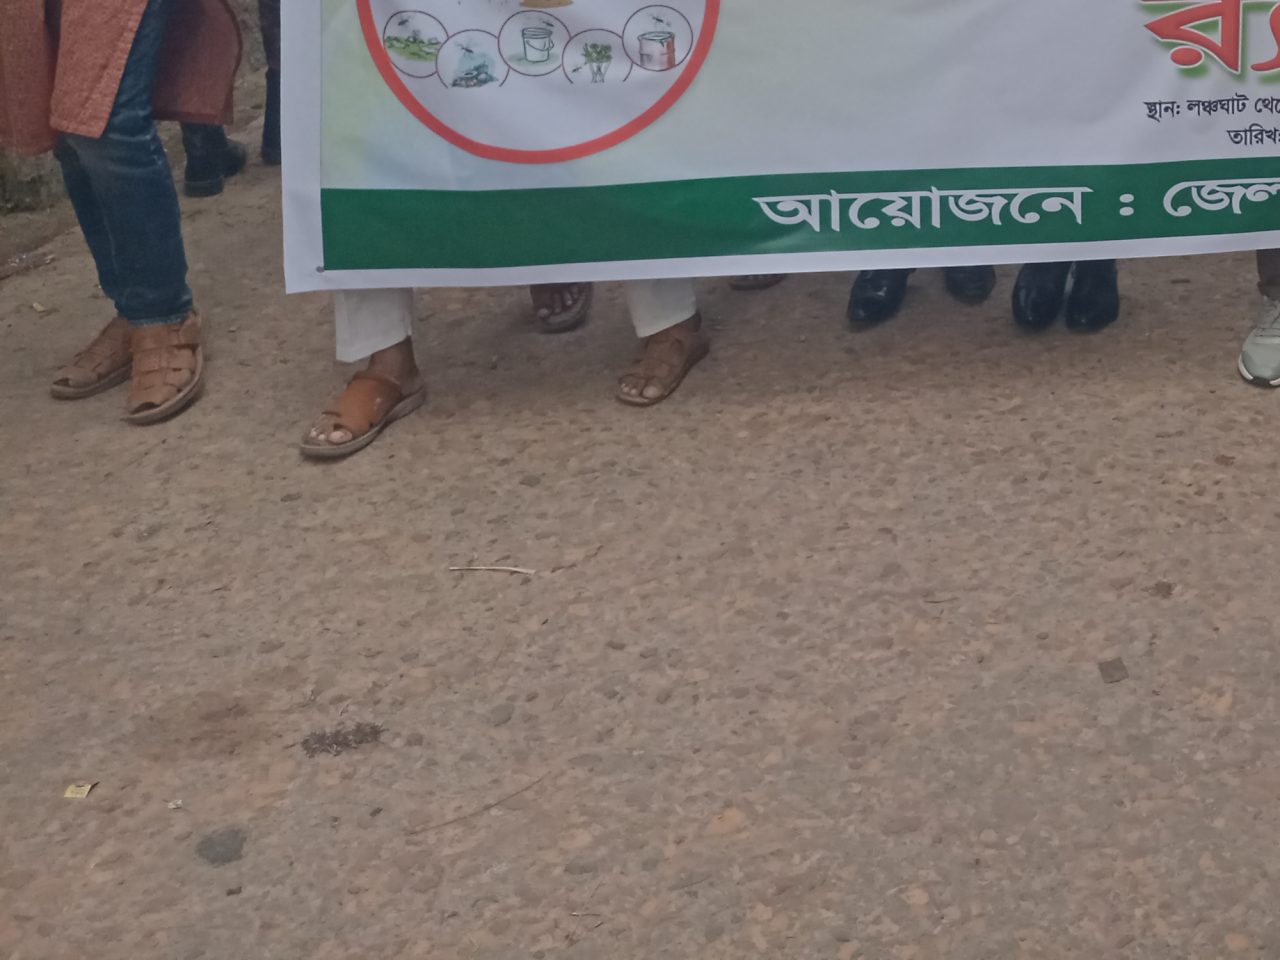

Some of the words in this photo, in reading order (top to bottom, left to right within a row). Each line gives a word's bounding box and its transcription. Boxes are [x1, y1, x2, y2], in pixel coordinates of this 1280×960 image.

[1144, 100, 1180, 121] স্থান:
[1186, 93, 1247, 115] লঞ্চঘাট
[753, 187, 1092, 232] আয়োজনে
